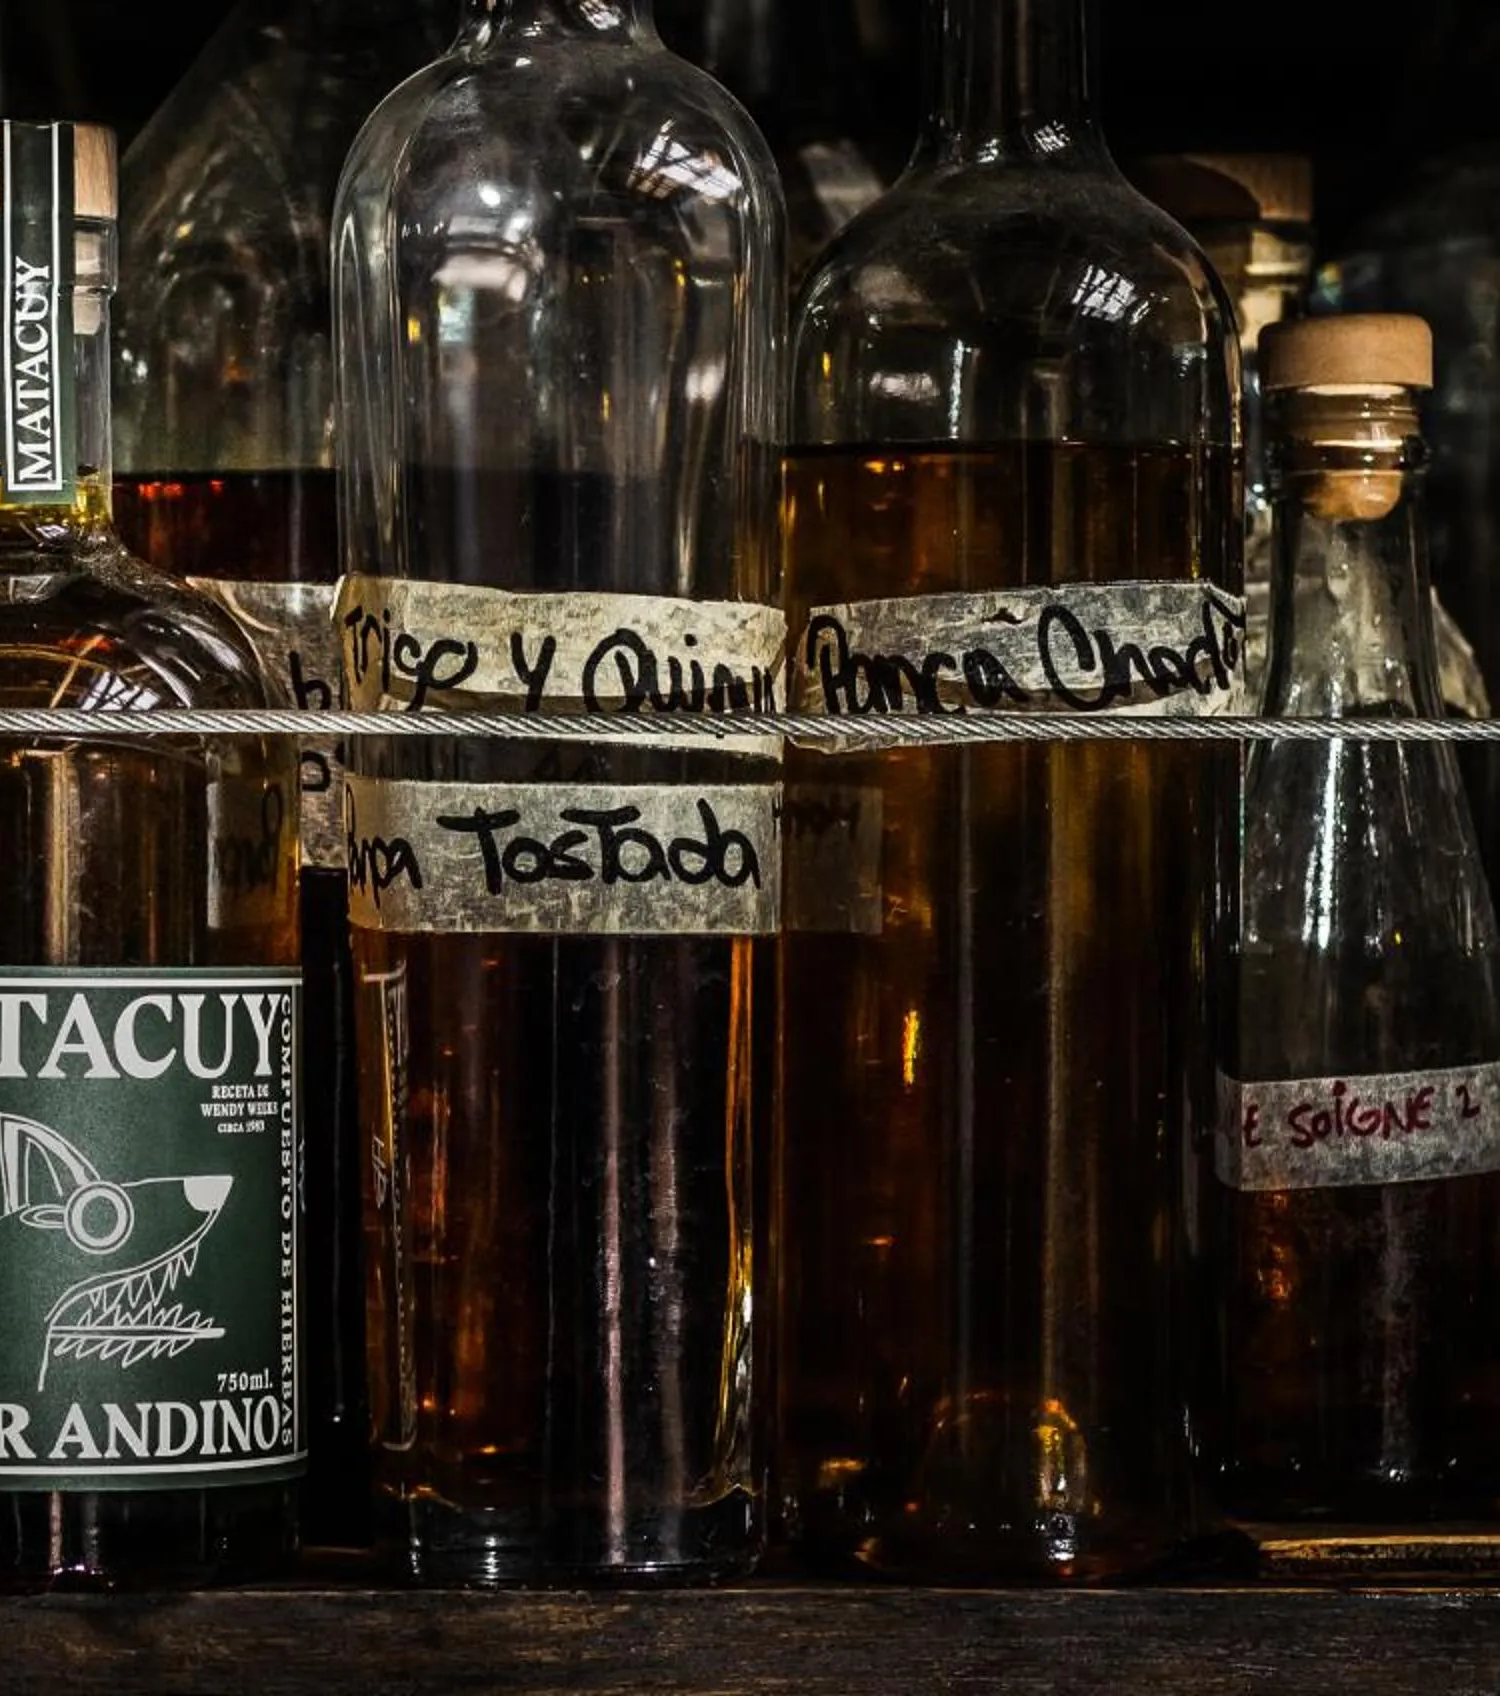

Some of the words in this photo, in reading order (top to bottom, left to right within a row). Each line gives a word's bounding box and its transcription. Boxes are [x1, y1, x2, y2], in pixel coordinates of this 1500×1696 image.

[15, 255, 53, 482] MATACUY
[200, 1102, 245, 1117] WENDY
[211, 1084, 254, 1099] RECETA
[217, 1122, 244, 1133] CIRCA
[280, 1231, 293, 1278] DE
[217, 1367, 273, 1393] 750ml.
[280, 1289, 293, 1446] HIERBAS
[48, 1394, 280, 1459] ANDINO
